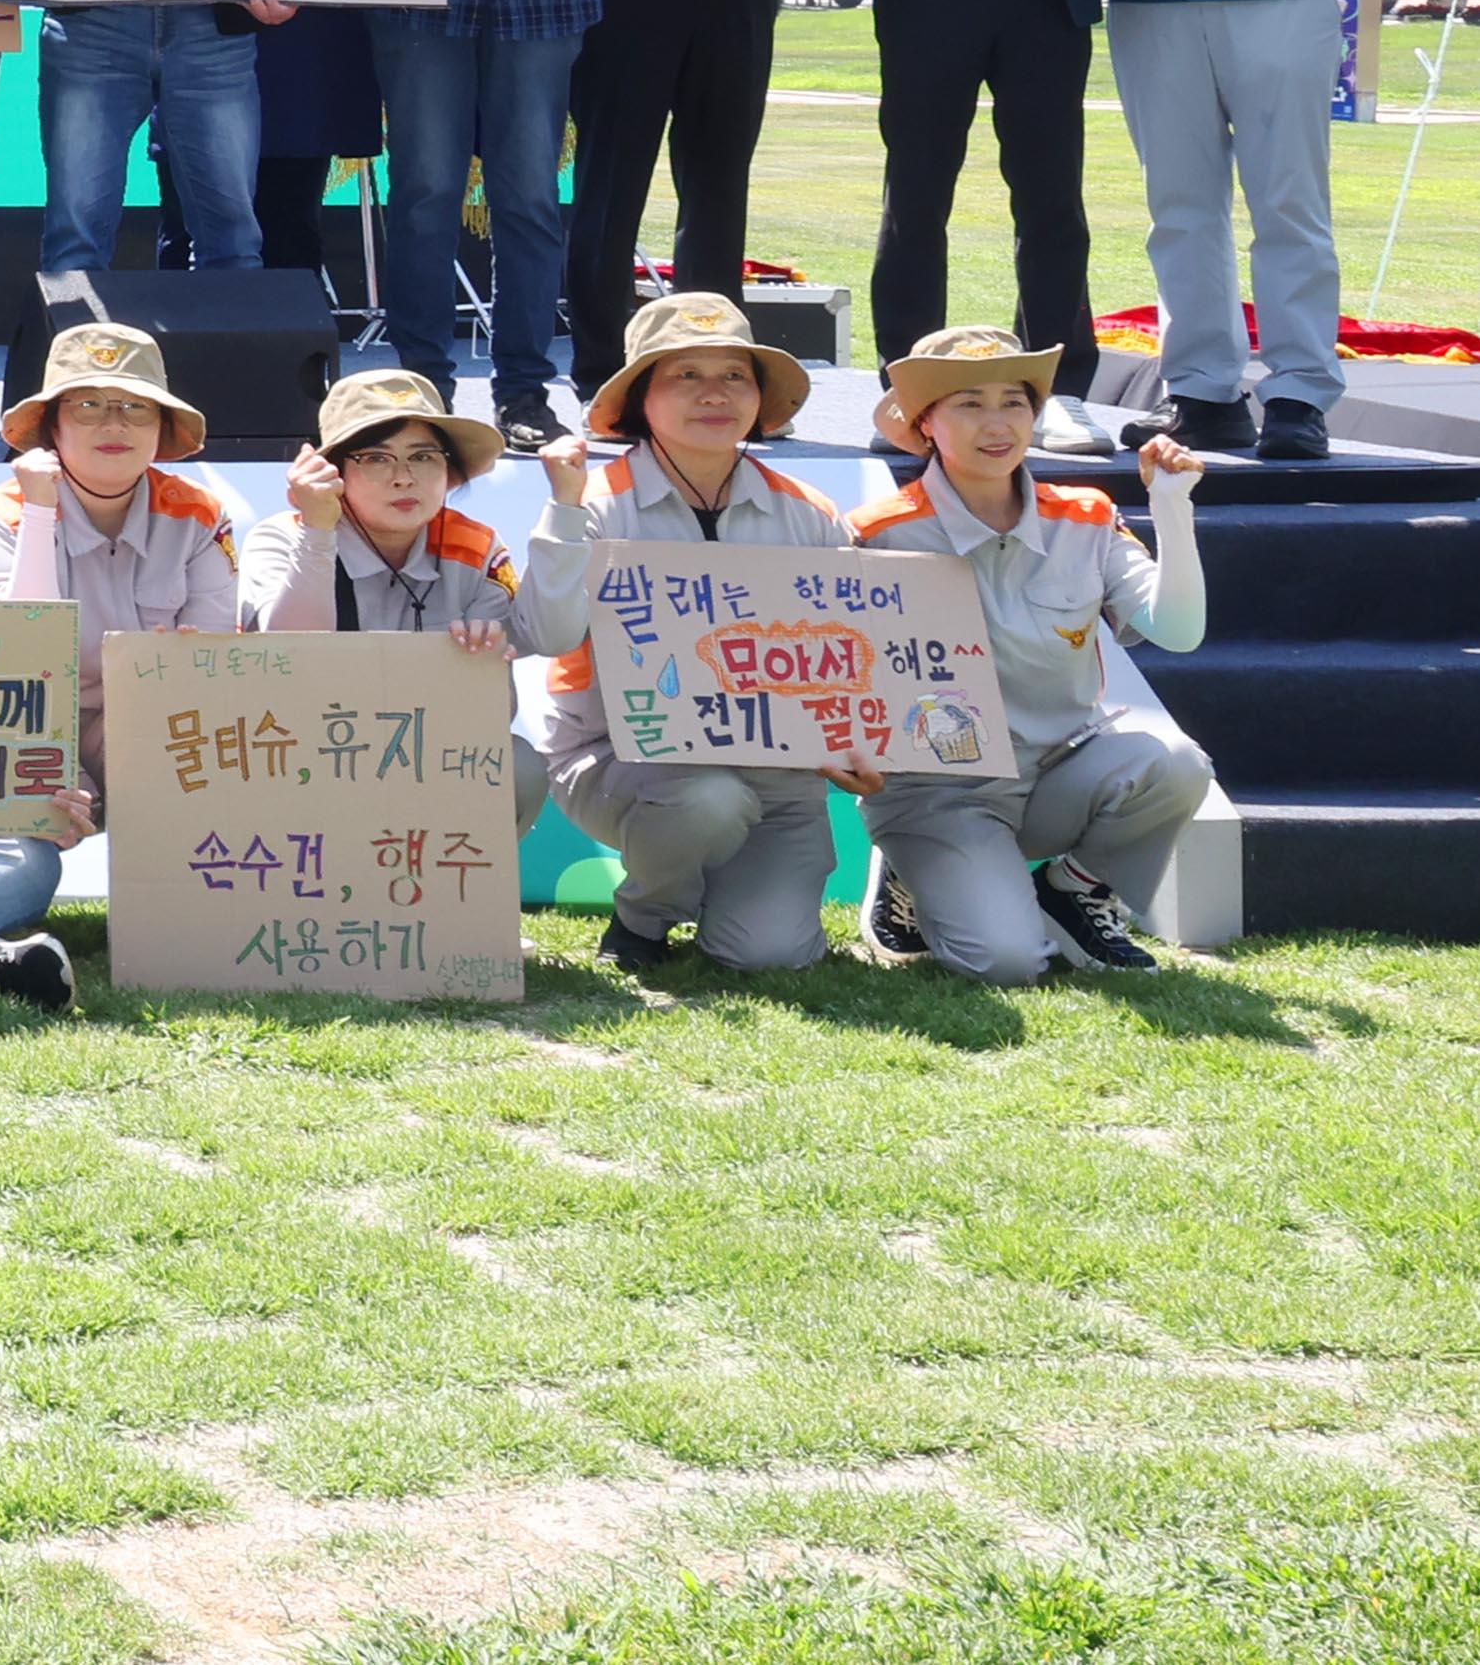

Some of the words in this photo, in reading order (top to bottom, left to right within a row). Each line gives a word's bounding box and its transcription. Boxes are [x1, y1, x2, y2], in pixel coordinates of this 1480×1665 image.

[597, 564, 756, 645] 빨래는
[794, 574, 903, 615] 한번에
[720, 637, 858, 692] 모아서
[319, 703, 425, 782] 휴지
[443, 747, 503, 785] 대신
[800, 696, 892, 757] 절약
[237, 918, 426, 975] 사용하기
